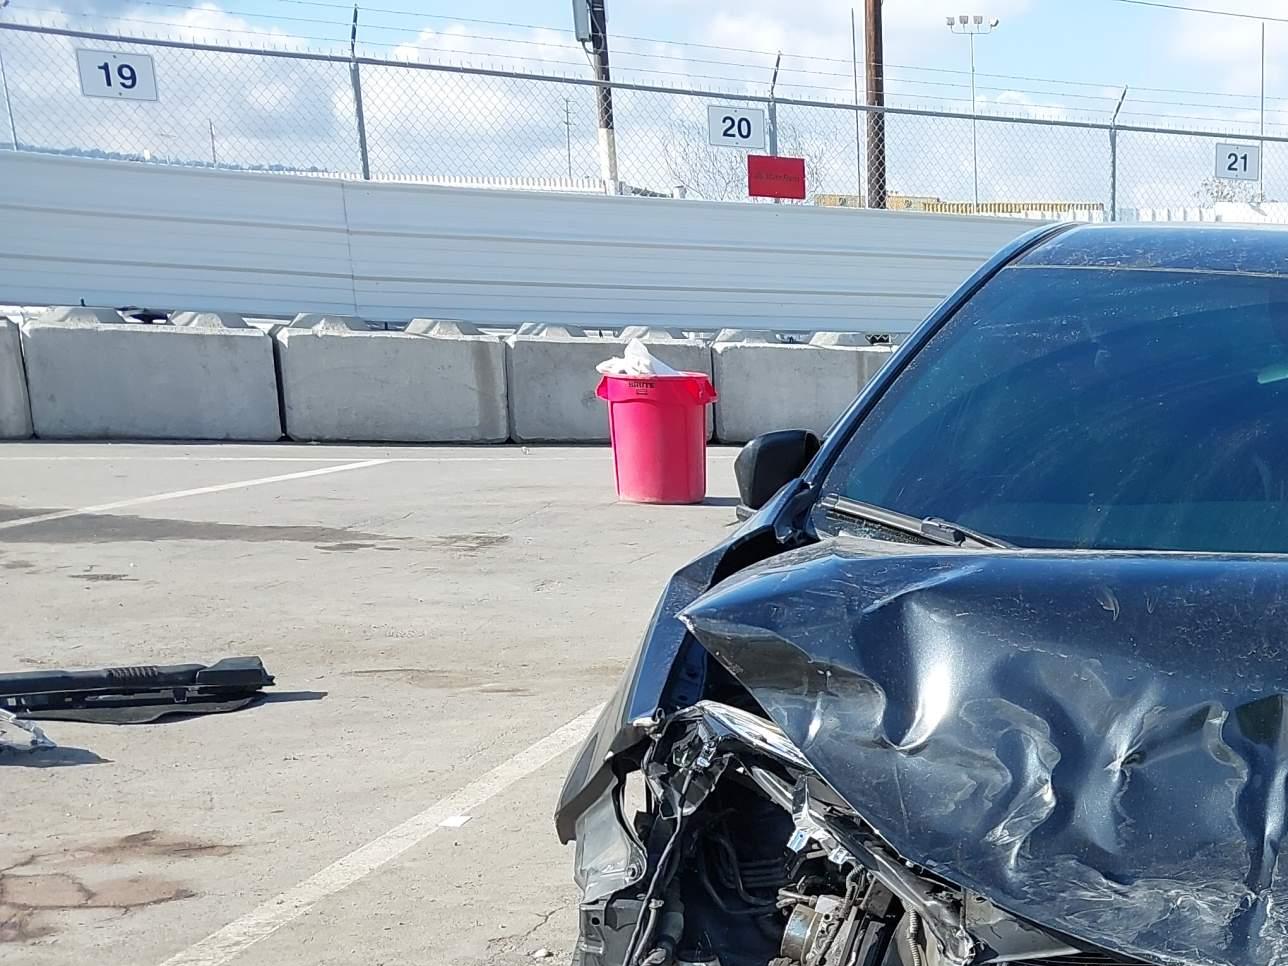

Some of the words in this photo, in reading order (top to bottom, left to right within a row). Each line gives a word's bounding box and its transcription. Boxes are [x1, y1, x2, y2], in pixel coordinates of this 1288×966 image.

[97, 62, 137, 89] 19
[721, 115, 752, 139] 20
[1227, 152, 1248, 172] 21
